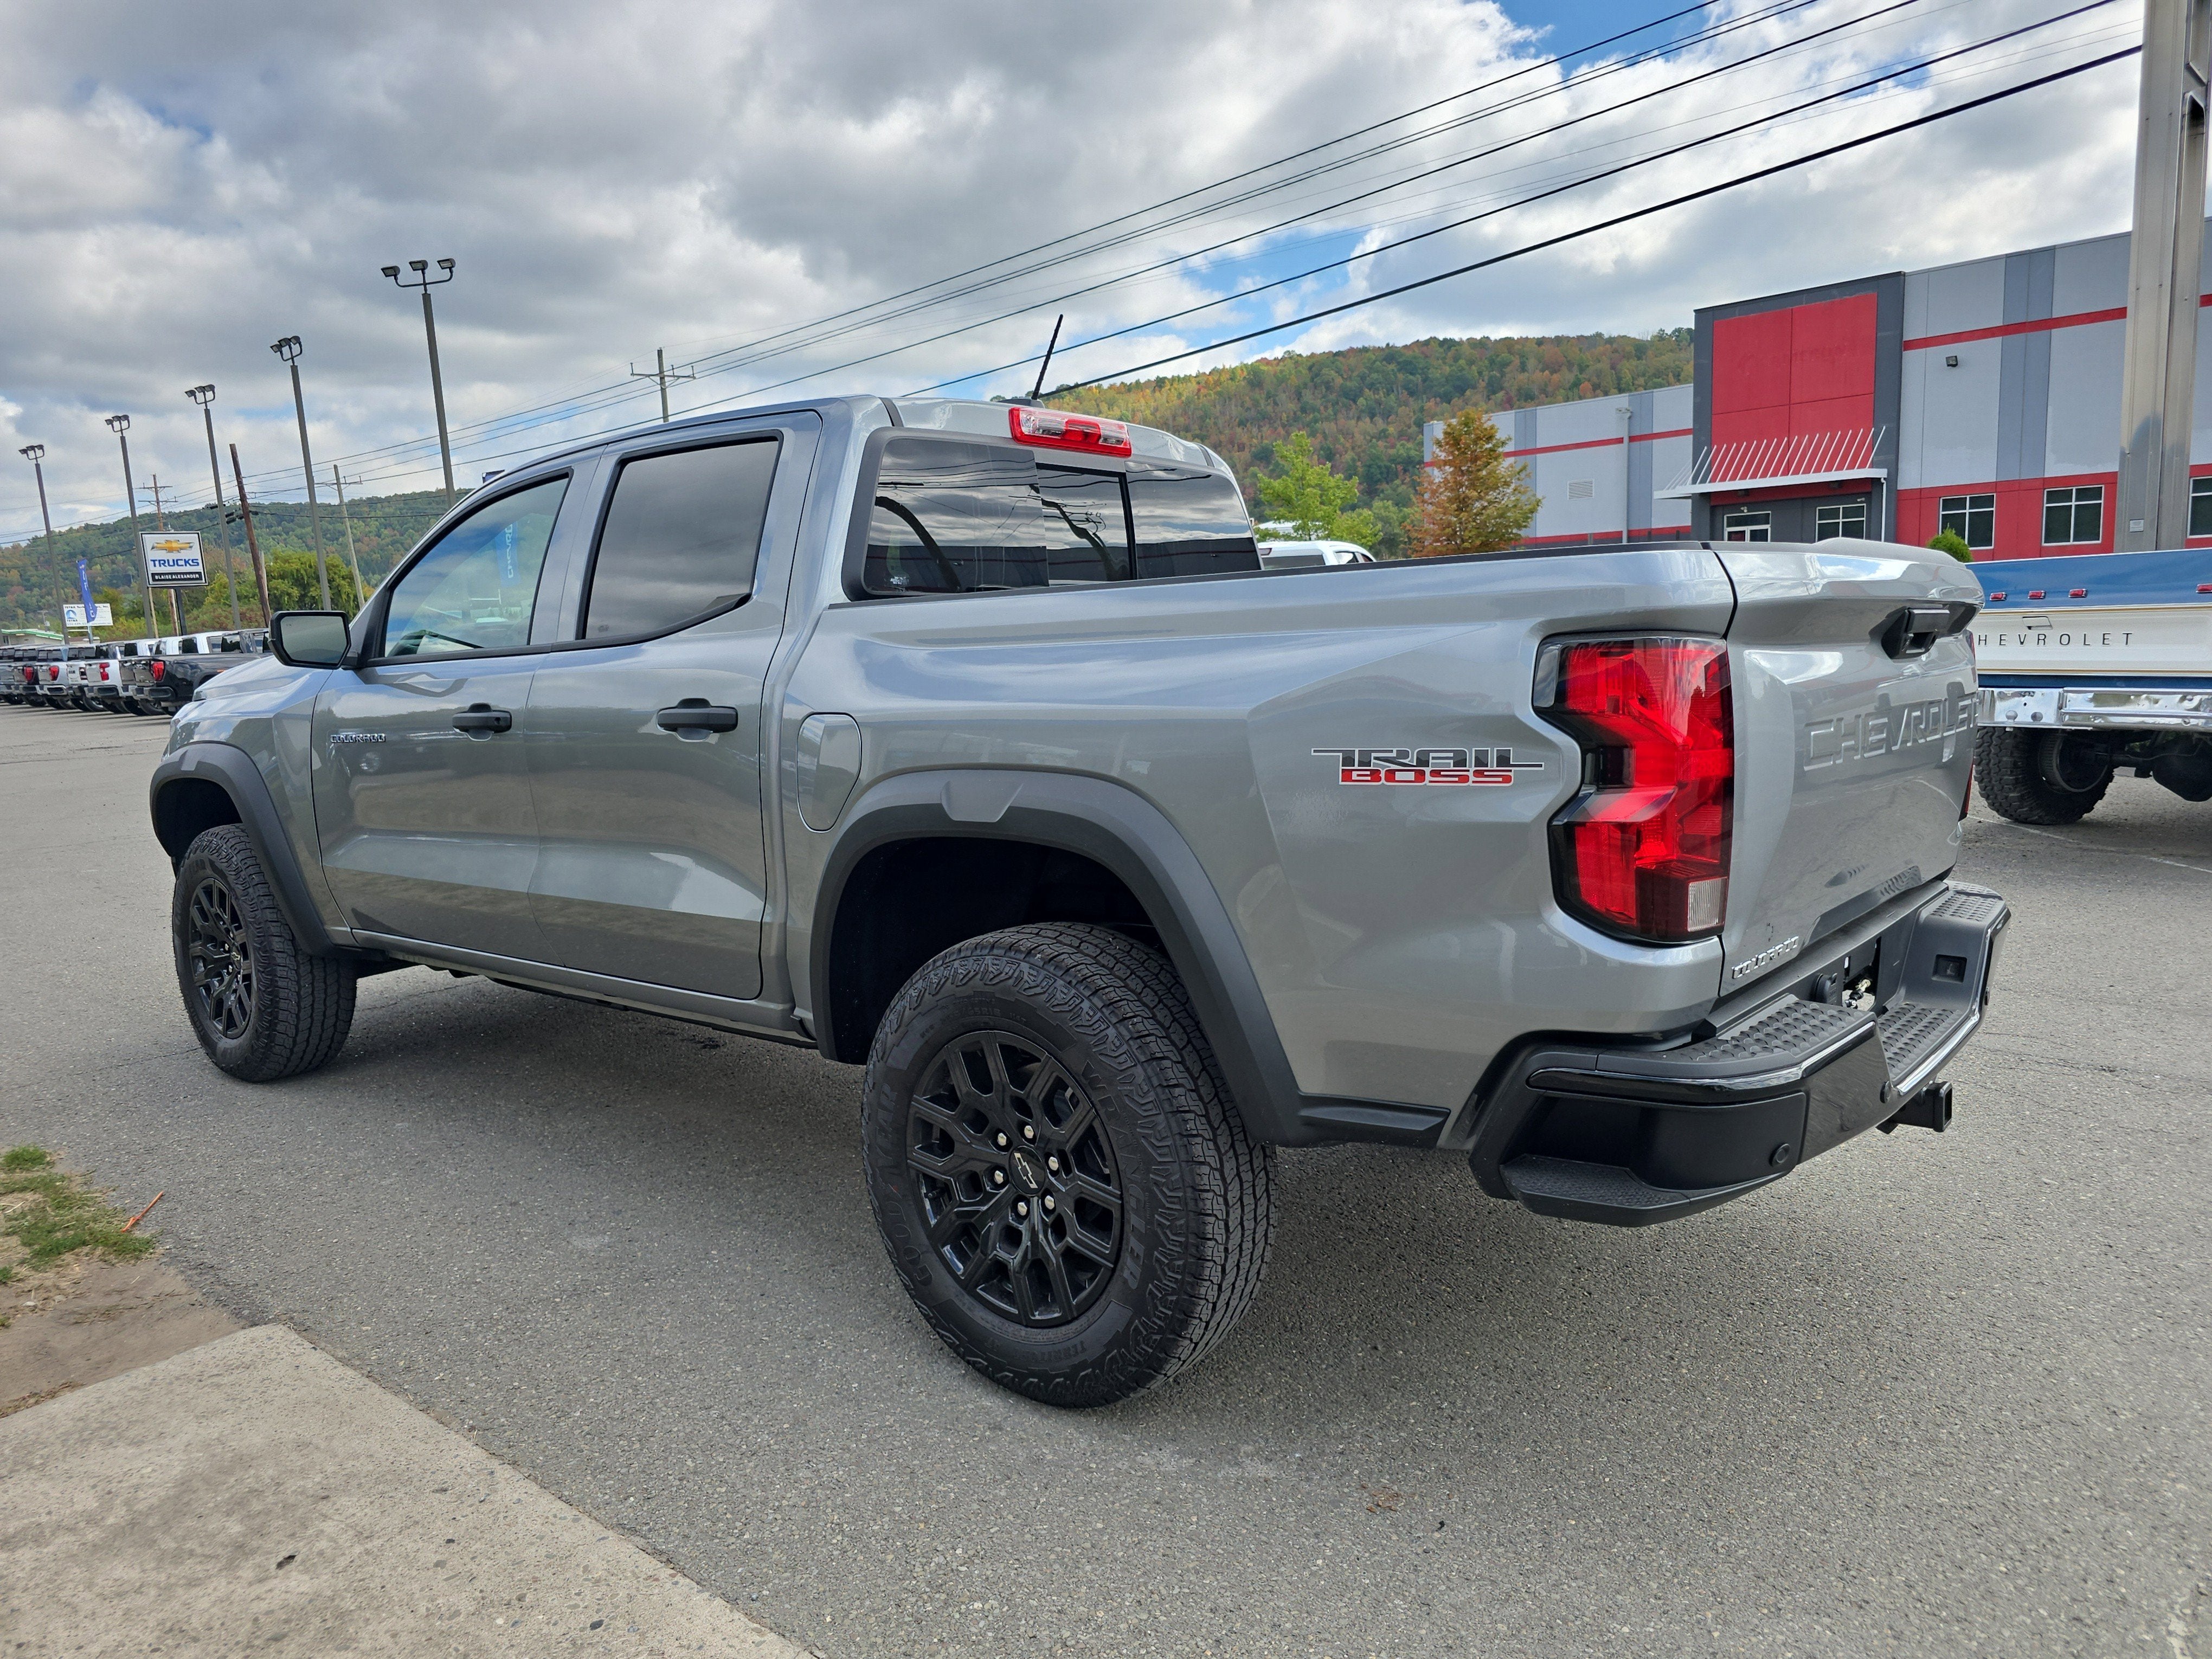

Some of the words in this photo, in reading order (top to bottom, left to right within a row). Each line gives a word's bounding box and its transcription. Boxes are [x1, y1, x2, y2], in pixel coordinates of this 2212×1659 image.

[150, 558, 200, 568] TRUCKS
[1978, 632, 2133, 646] HEVROLET
[330, 732, 386, 743] COLORADO
[1803, 692, 1979, 771] CHEVROLET
[1311, 747, 1545, 770] TRAIL
[1339, 768, 1514, 787] BOSS
[1732, 936, 1799, 979] COLORADO
[875, 1083, 934, 1287] GOODYEAR
[1081, 1059, 1146, 1290] WRANGLER
